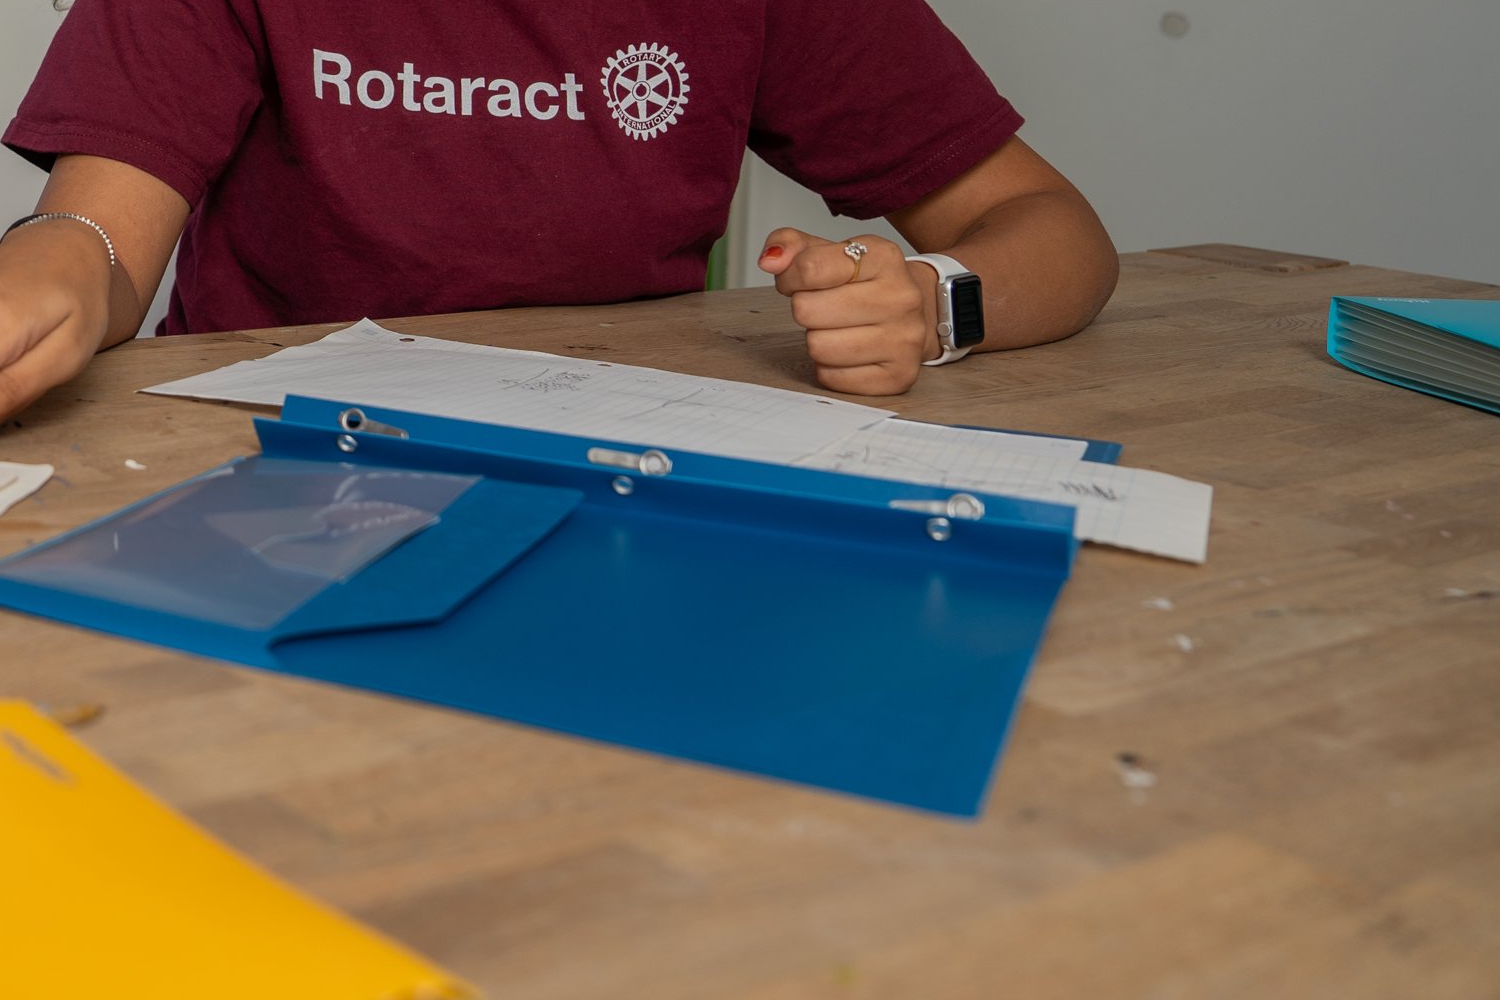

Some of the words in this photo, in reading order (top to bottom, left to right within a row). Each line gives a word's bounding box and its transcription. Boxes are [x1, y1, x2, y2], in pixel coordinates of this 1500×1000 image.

[622, 53, 663, 66] ROTARY
[312, 47, 586, 121] Rotaract
[617, 103, 676, 130] INTERNATIONAL
